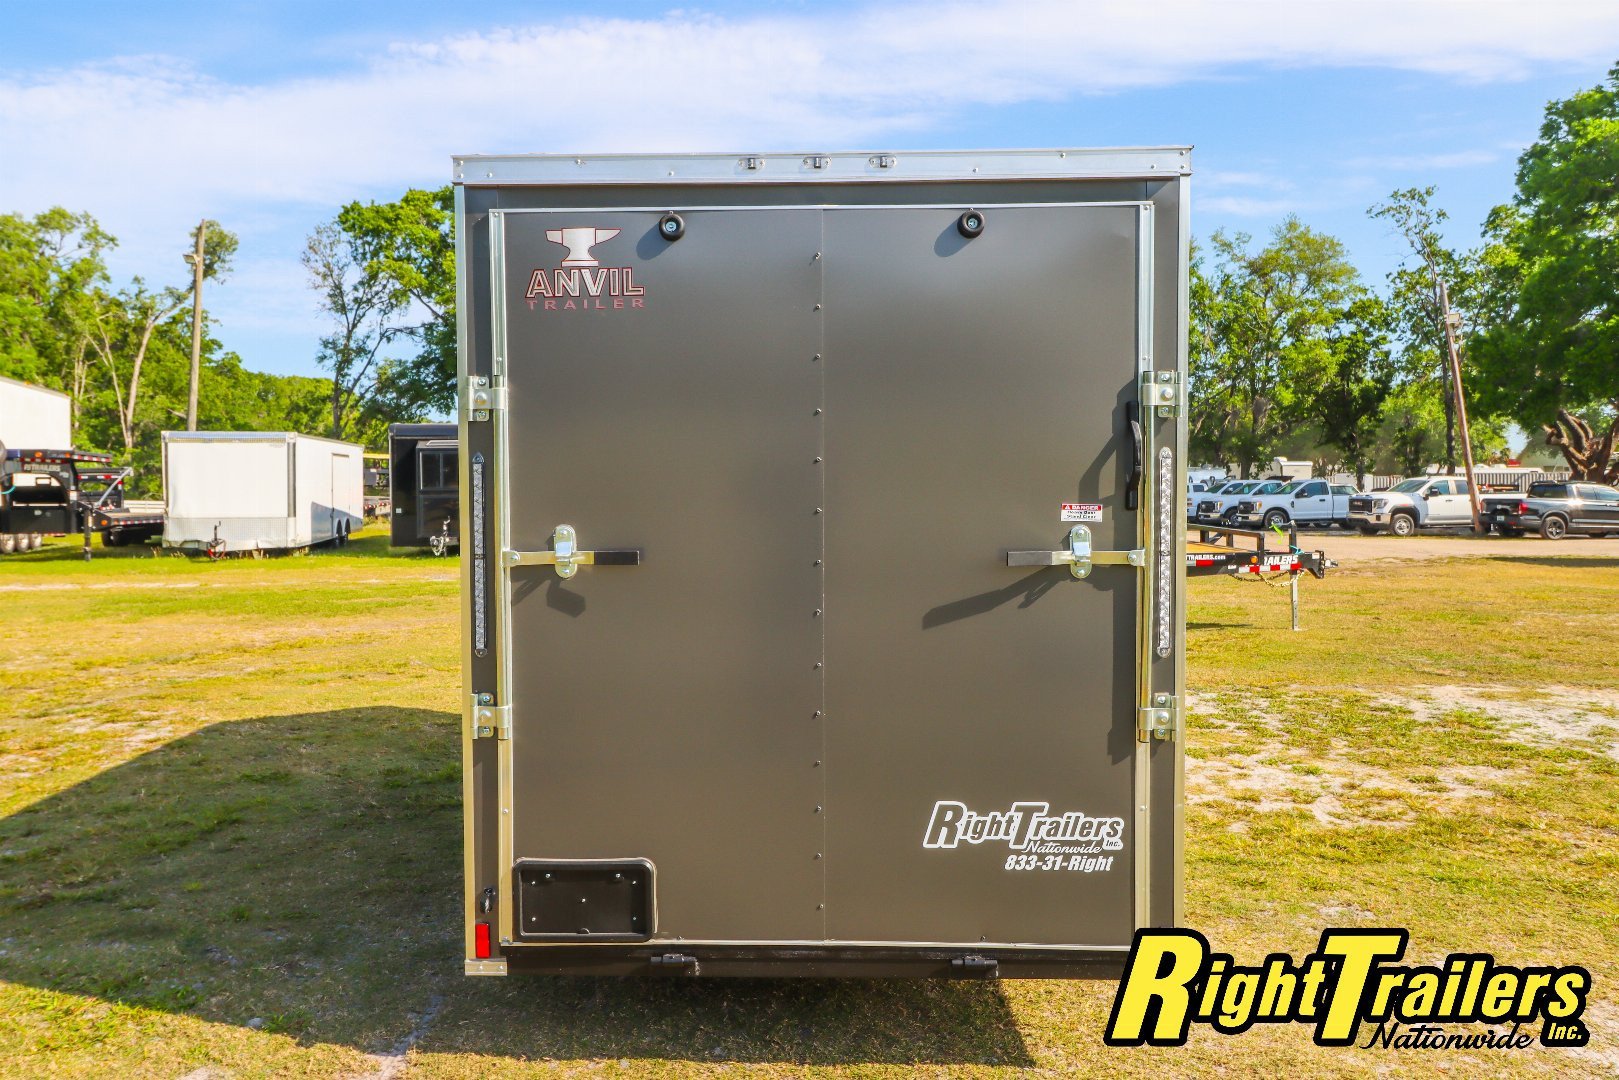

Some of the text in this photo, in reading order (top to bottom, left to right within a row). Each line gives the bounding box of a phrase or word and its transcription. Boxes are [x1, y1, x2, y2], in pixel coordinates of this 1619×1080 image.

[525, 267, 645, 298] ANVIL
[526, 299, 645, 310] TRAILER
[1021, 839, 1120, 854] Nationwide Inc.
[1004, 855, 1114, 873] 833-31-Right
